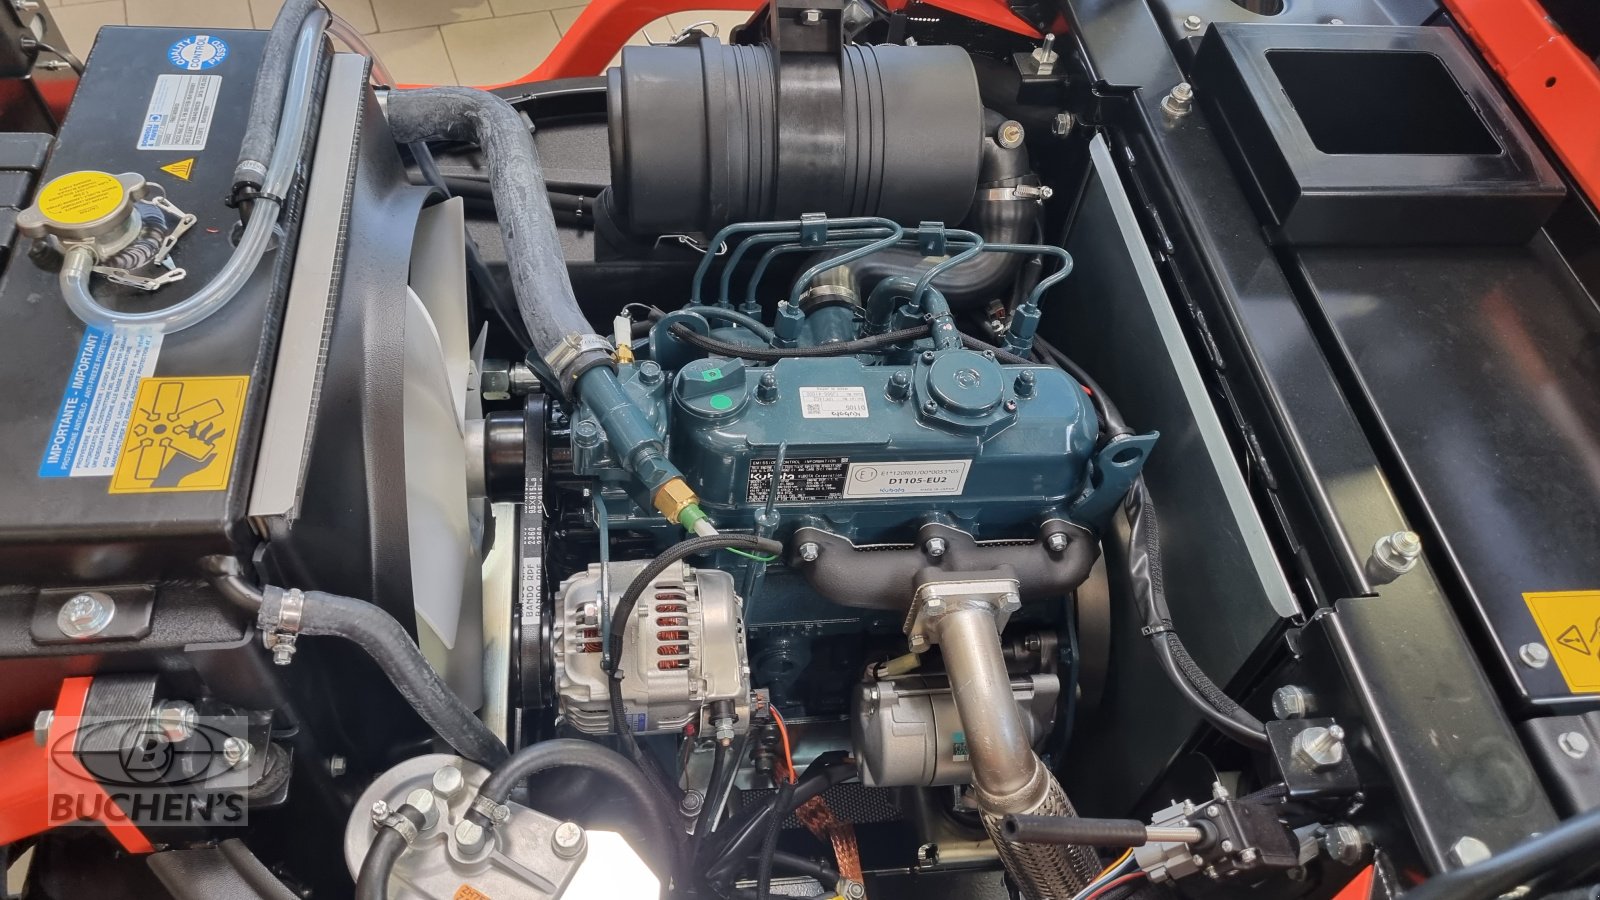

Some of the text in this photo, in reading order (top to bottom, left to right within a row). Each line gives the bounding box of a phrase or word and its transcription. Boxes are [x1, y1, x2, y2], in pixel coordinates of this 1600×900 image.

[170, 38, 191, 65] QUALITY
[190, 37, 207, 67] CONTROL
[208, 40, 227, 65] PASSED
[46, 397, 78, 463] IMPORTANTE
[71, 333, 99, 388] IMPORTANT
[60, 431, 78, 469] PROTEZIONE
[73, 402, 87, 430] ANTIGELO
[83, 362, 101, 398] ANTI-FREEZE
[889, 477, 947, 485] D1105-EU2
[527, 527, 536, 545] 2360
[525, 564, 534, 617] BANDO RPF
